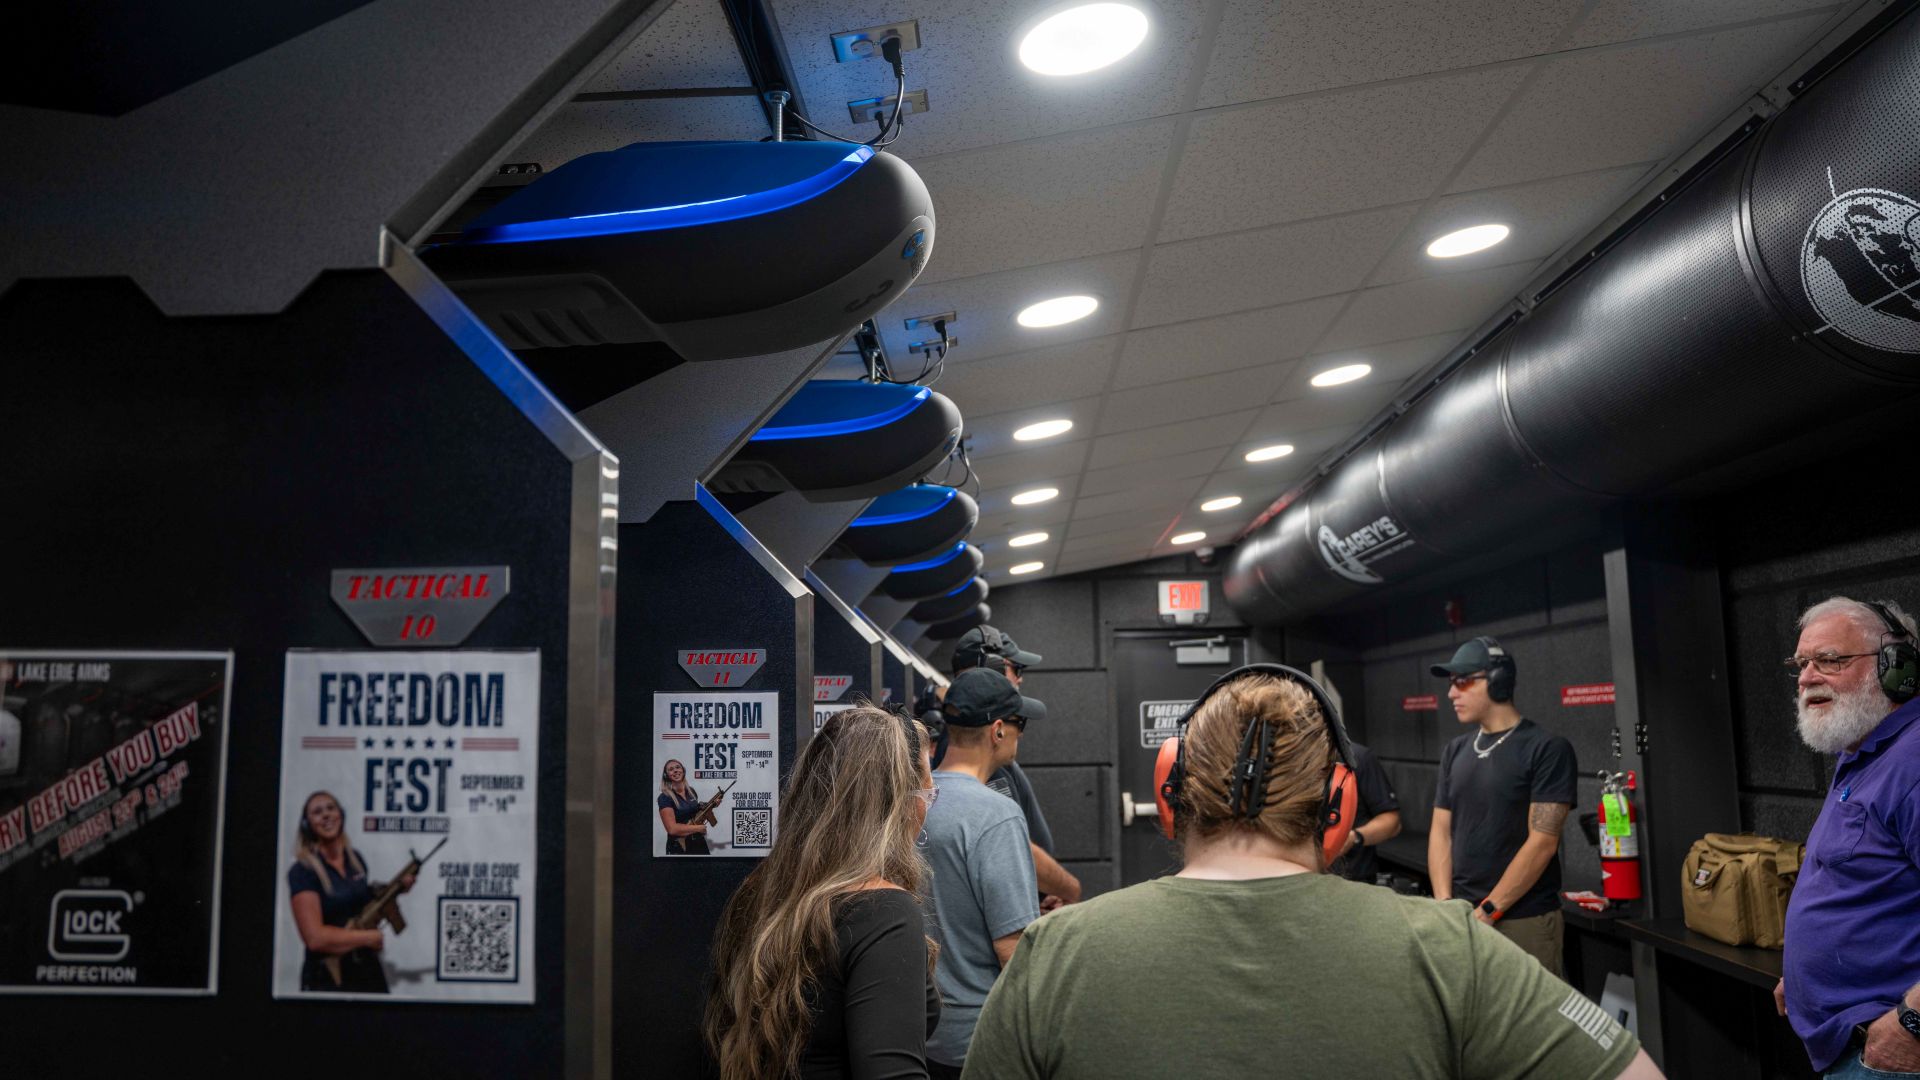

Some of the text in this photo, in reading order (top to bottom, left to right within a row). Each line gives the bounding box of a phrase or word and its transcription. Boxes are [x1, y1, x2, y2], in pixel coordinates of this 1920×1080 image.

[347, 574, 491, 600] TACTICAL
[1168, 583, 1204, 610] EXIT
[401, 614, 436, 640] 10
[687, 652, 758, 665] TACTICAL
[17, 663, 111, 682] LAKE ERIE ARMS
[713, 672, 731, 685] 11
[814, 677, 847, 686] CTICAL
[318, 672, 505, 727] FREEDOM
[817, 690, 829, 698] 12
[670, 702, 762, 729] FREEDOM
[1147, 704, 1194, 718] EMERG
[1154, 717, 1178, 729] EXIT
[695, 743, 738, 769] FEST
[0, 804, 25, 851] RY
[28, 757, 110, 833] BEFORE
[106, 729, 156, 783] YOU
[153, 701, 201, 758] BUY
[461, 774, 524, 790] SEPTEMBER
[702, 771, 714, 779] LAKE
[364, 756, 453, 813] FEST
[733, 792, 747, 800] SCAN
[758, 792, 772, 800] CODE
[736, 800, 746, 808] FOR
[58, 808, 112, 859] AUGUST
[439, 862, 470, 879] SCAN
[48, 889, 133, 961] GLOCK
[36, 965, 137, 983] PERFECTION
